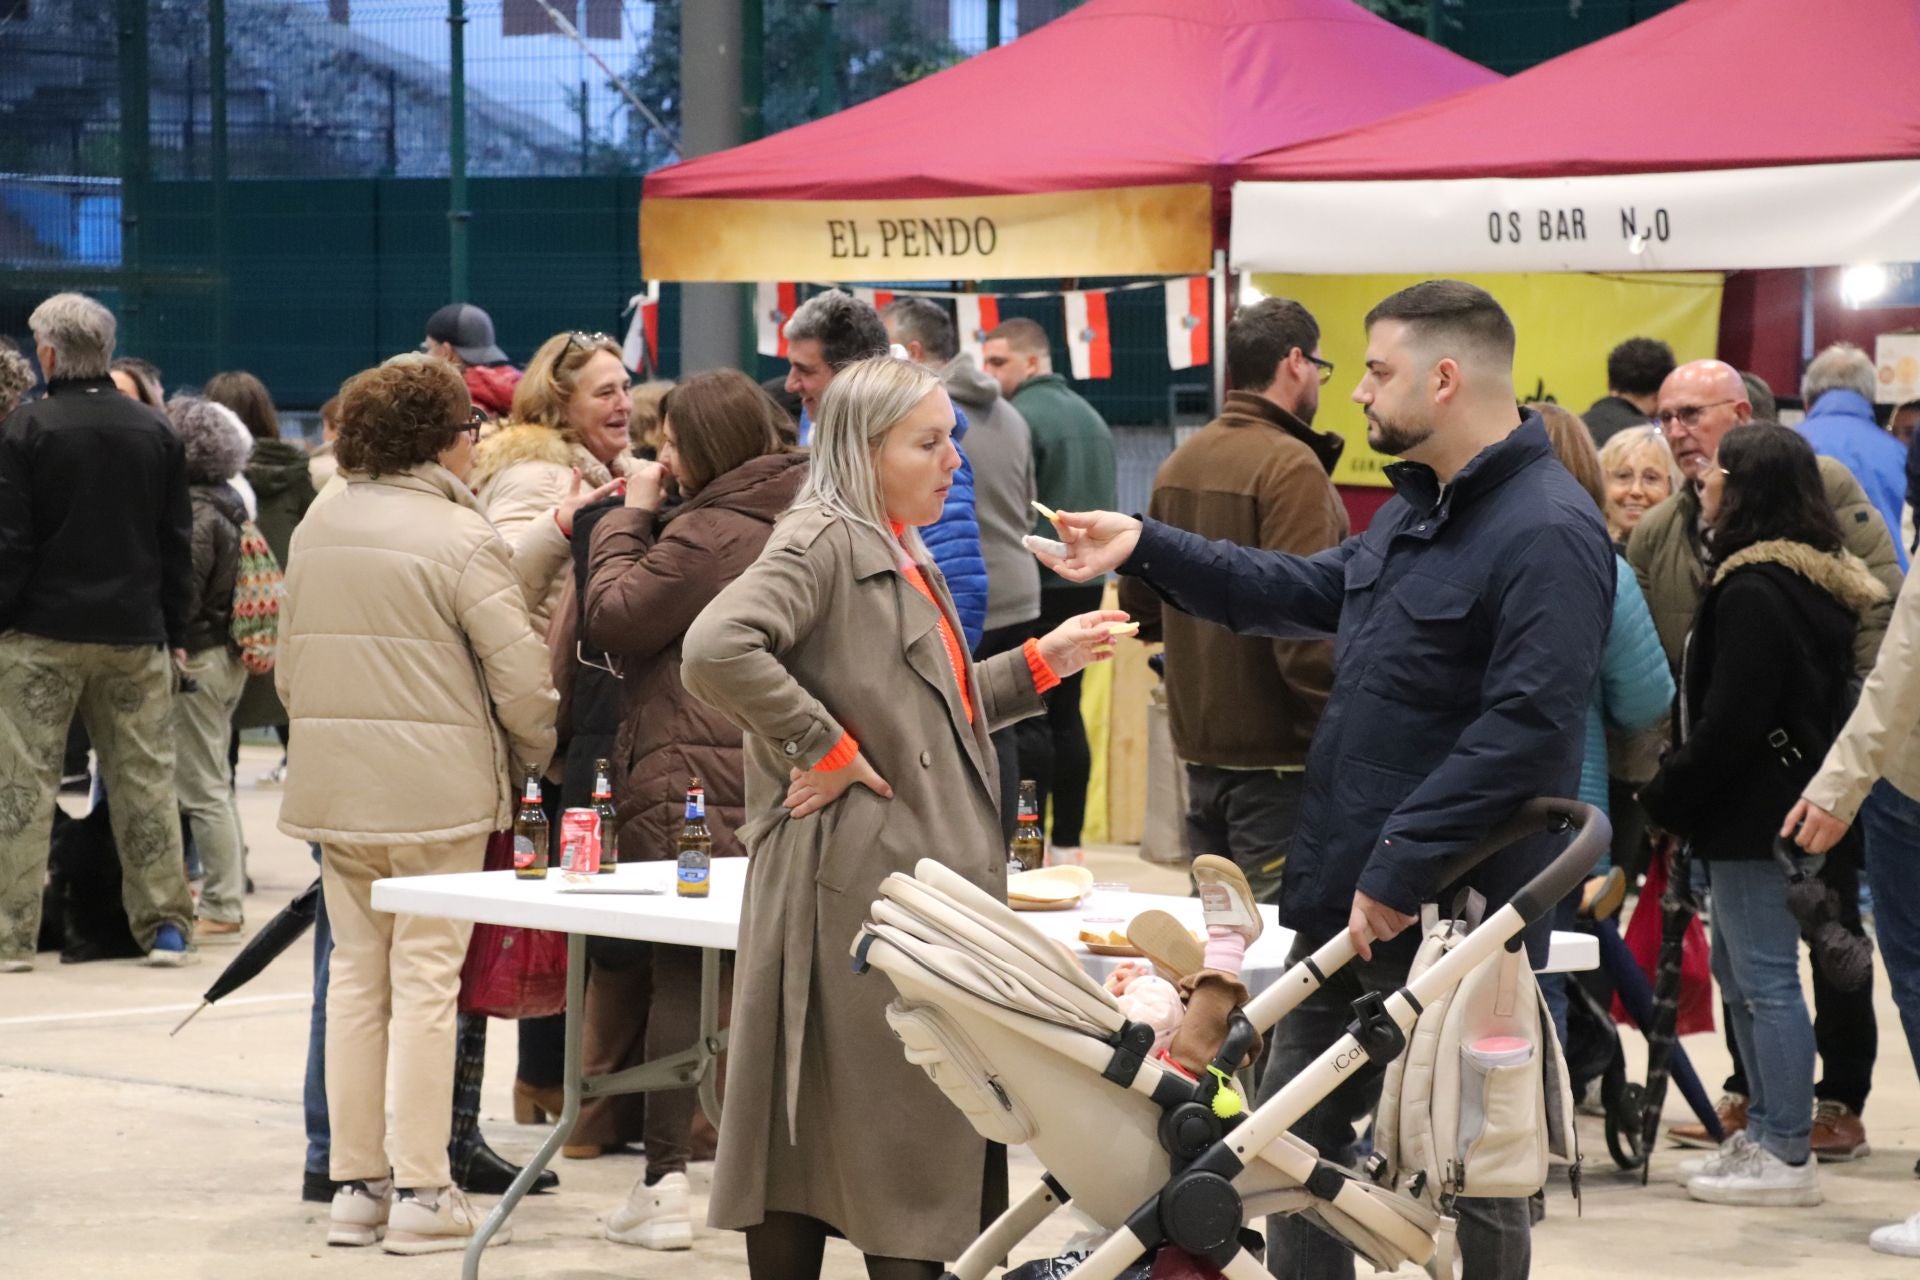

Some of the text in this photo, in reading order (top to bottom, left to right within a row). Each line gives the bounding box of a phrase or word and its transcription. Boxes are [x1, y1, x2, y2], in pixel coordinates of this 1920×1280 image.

[827, 216, 997, 258] EL PENDO
[1488, 211, 1521, 243] OS
[1538, 208, 1587, 241] BAR
